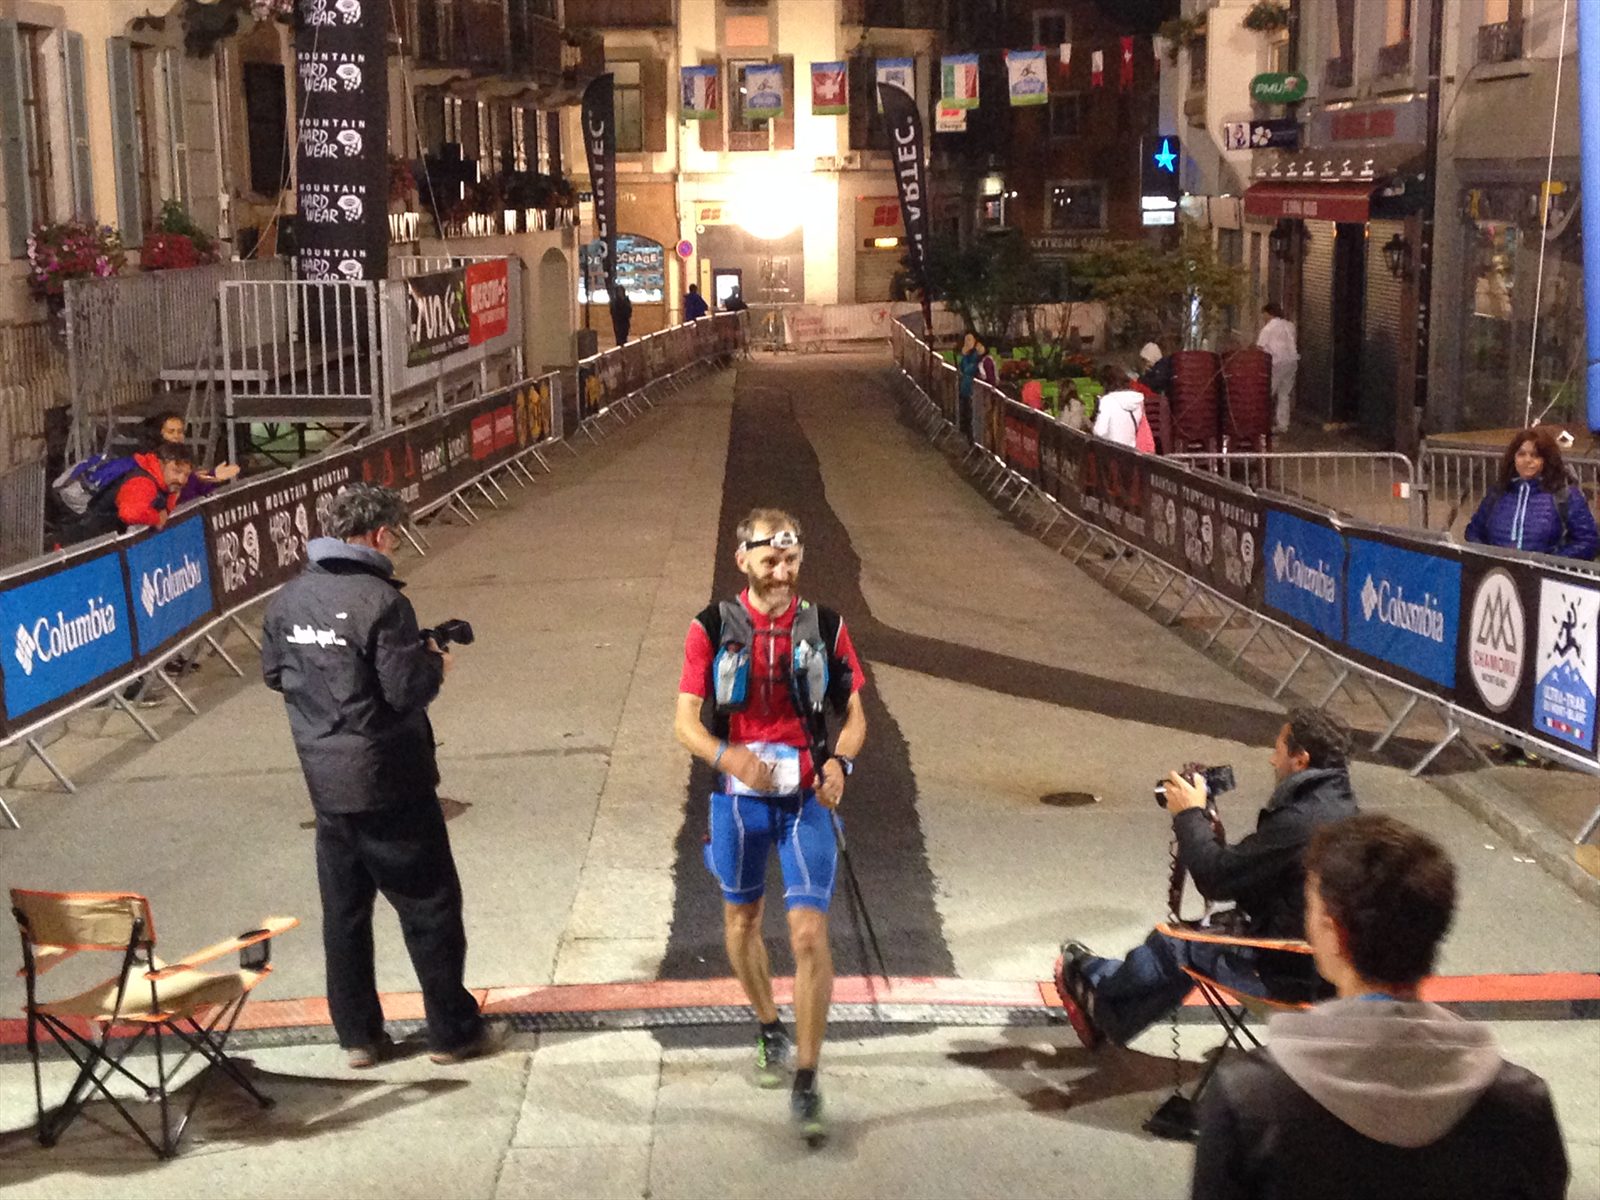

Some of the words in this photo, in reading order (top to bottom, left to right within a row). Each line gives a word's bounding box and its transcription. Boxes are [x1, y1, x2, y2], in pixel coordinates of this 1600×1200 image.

[298, 52, 366, 62] MOUNTAIN
[304, 77, 338, 93] WEAR
[1255, 83, 1284, 94] PMU
[300, 118, 366, 128] MOUNTAIN
[305, 143, 339, 159] WEAR
[300, 183, 367, 194] MOUNTAIN
[305, 208, 339, 224] WEAR
[301, 247, 367, 258] MOUNTAIN
[266, 483, 307, 511] MOUNTAIN
[212, 500, 259, 532] MOUNTAIN
[1286, 545, 1336, 604] Columbia
[1378, 580, 1444, 643] Columbia
[33, 596, 116, 663] Columbia
